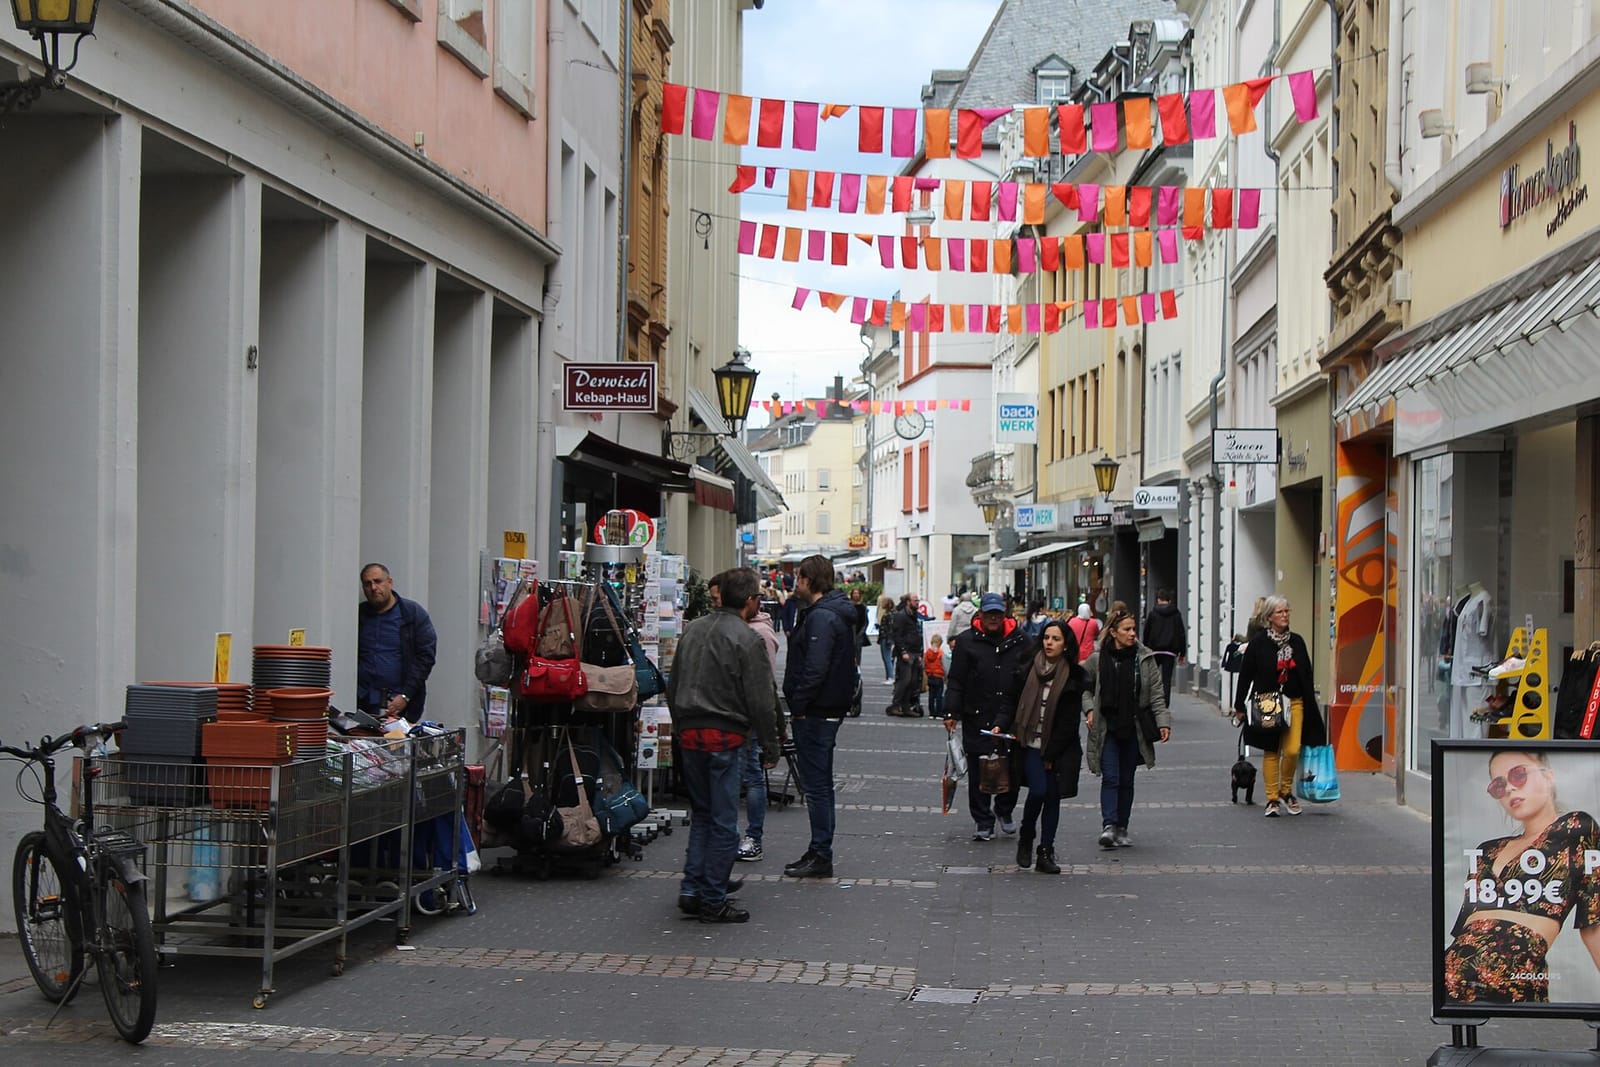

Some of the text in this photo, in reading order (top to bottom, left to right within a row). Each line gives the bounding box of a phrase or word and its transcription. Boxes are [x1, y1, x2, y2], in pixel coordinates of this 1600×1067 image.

[572, 369, 647, 388] Derwisch
[575, 391, 647, 405] Kebap-Haus
[1001, 405, 1034, 418] back
[1000, 420, 1034, 431] WERK
[1225, 439, 1264, 450] Queen
[1222, 452, 1244, 462] Nails
[1252, 452, 1269, 463] Spa
[1017, 508, 1053, 526] back WERK
[1075, 515, 1109, 523] CASINO
[1463, 879, 1563, 908] 18,99€
